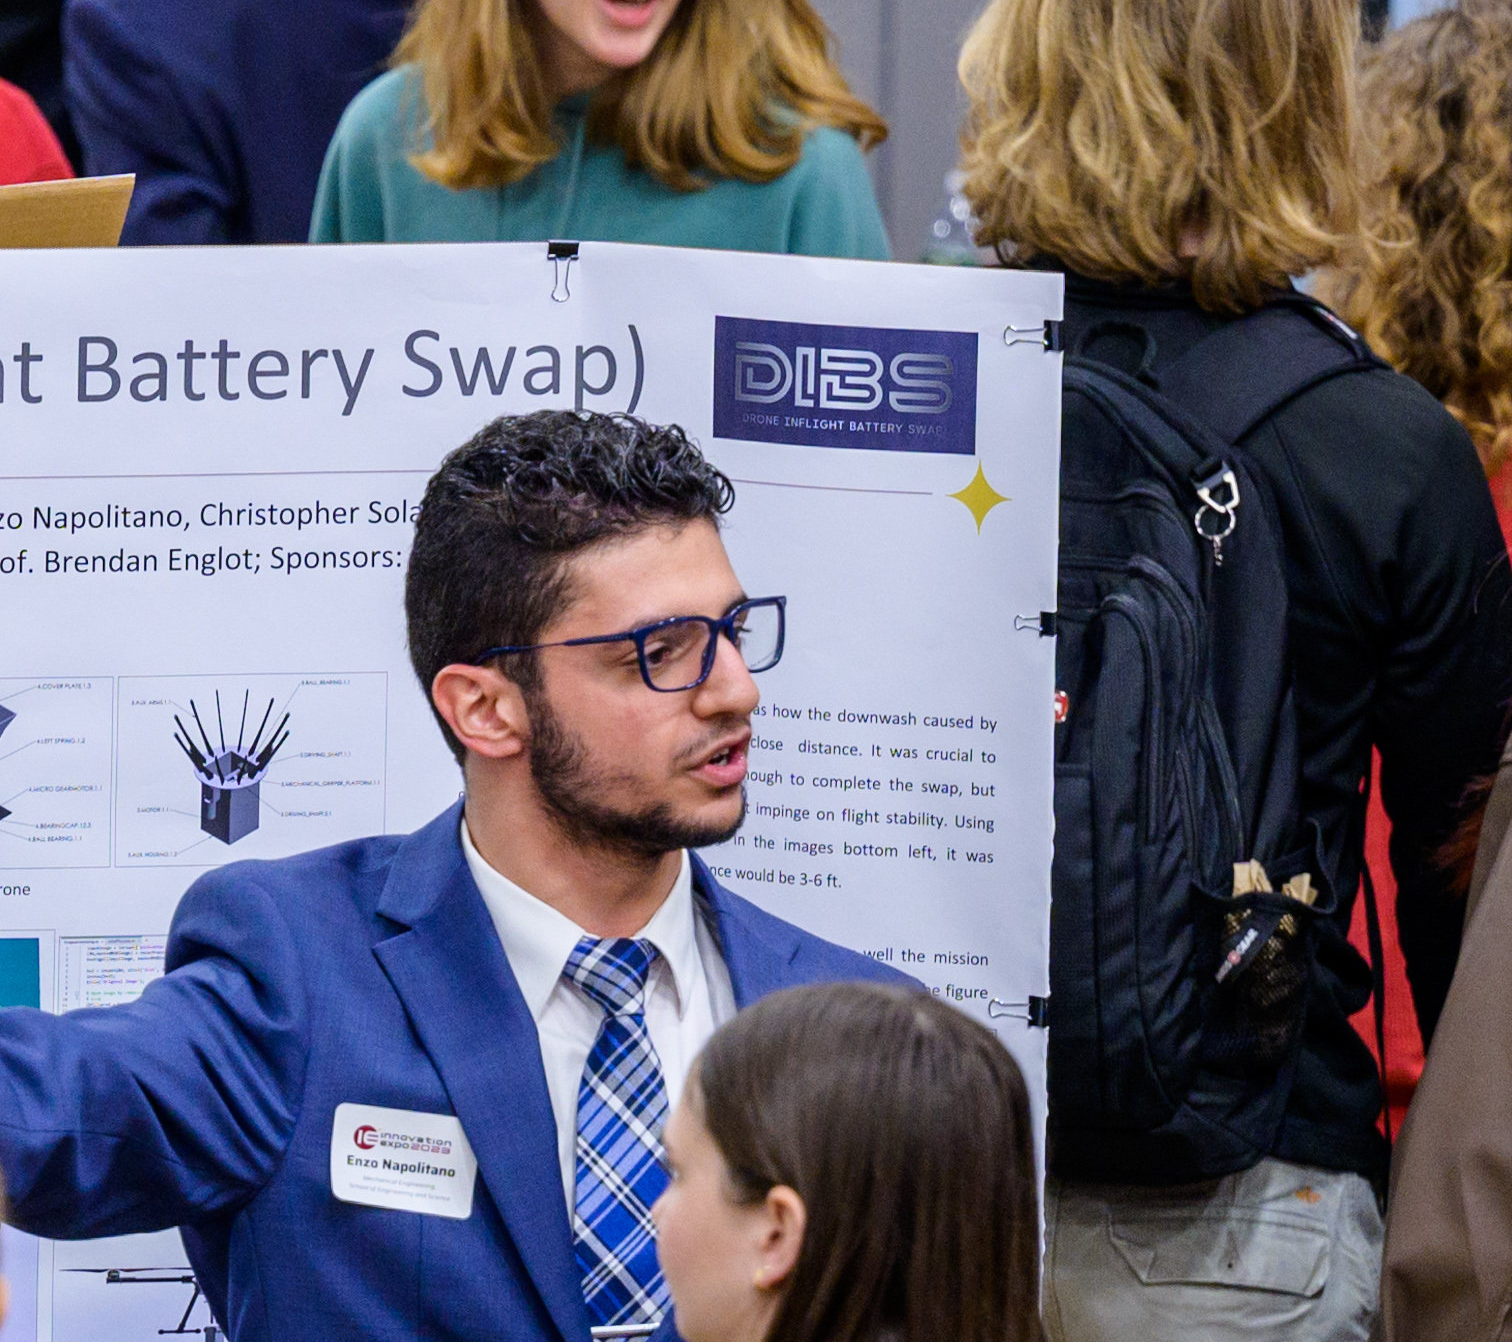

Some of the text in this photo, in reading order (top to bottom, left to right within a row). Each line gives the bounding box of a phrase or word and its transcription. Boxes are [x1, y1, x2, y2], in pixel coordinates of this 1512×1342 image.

[79, 335, 374, 416] Battery
[402, 324, 646, 414] Swap)
[735, 341, 953, 413] DIBS
[743, 413, 944, 435] DRONE INFLIGHT BATTERY SWAP
[32, 502, 191, 537] Napolitano,
[201, 499, 357, 531] Christopher
[44, 547, 158, 573] Brendan
[168, 545, 261, 576] Englot;
[270, 544, 402, 575] Sponsors:
[753, 704, 997, 732] as how the downwash caused by
[750, 737, 996, 763] close distance. It was crucial to
[790, 773, 995, 797] to complete the swap, but
[756, 803, 994, 833] impinge on flight stability. Using
[735, 835, 994, 863] in the images bottom left, it was
[735, 867, 841, 888] would be 3-6 ft.
[902, 950, 988, 965] the mission
[946, 985, 988, 1000] figure
[380, 1132, 451, 1147] innovation
[380, 1141, 450, 1154] expo 2023
[347, 1155, 455, 1177] Enzo Napolitano
